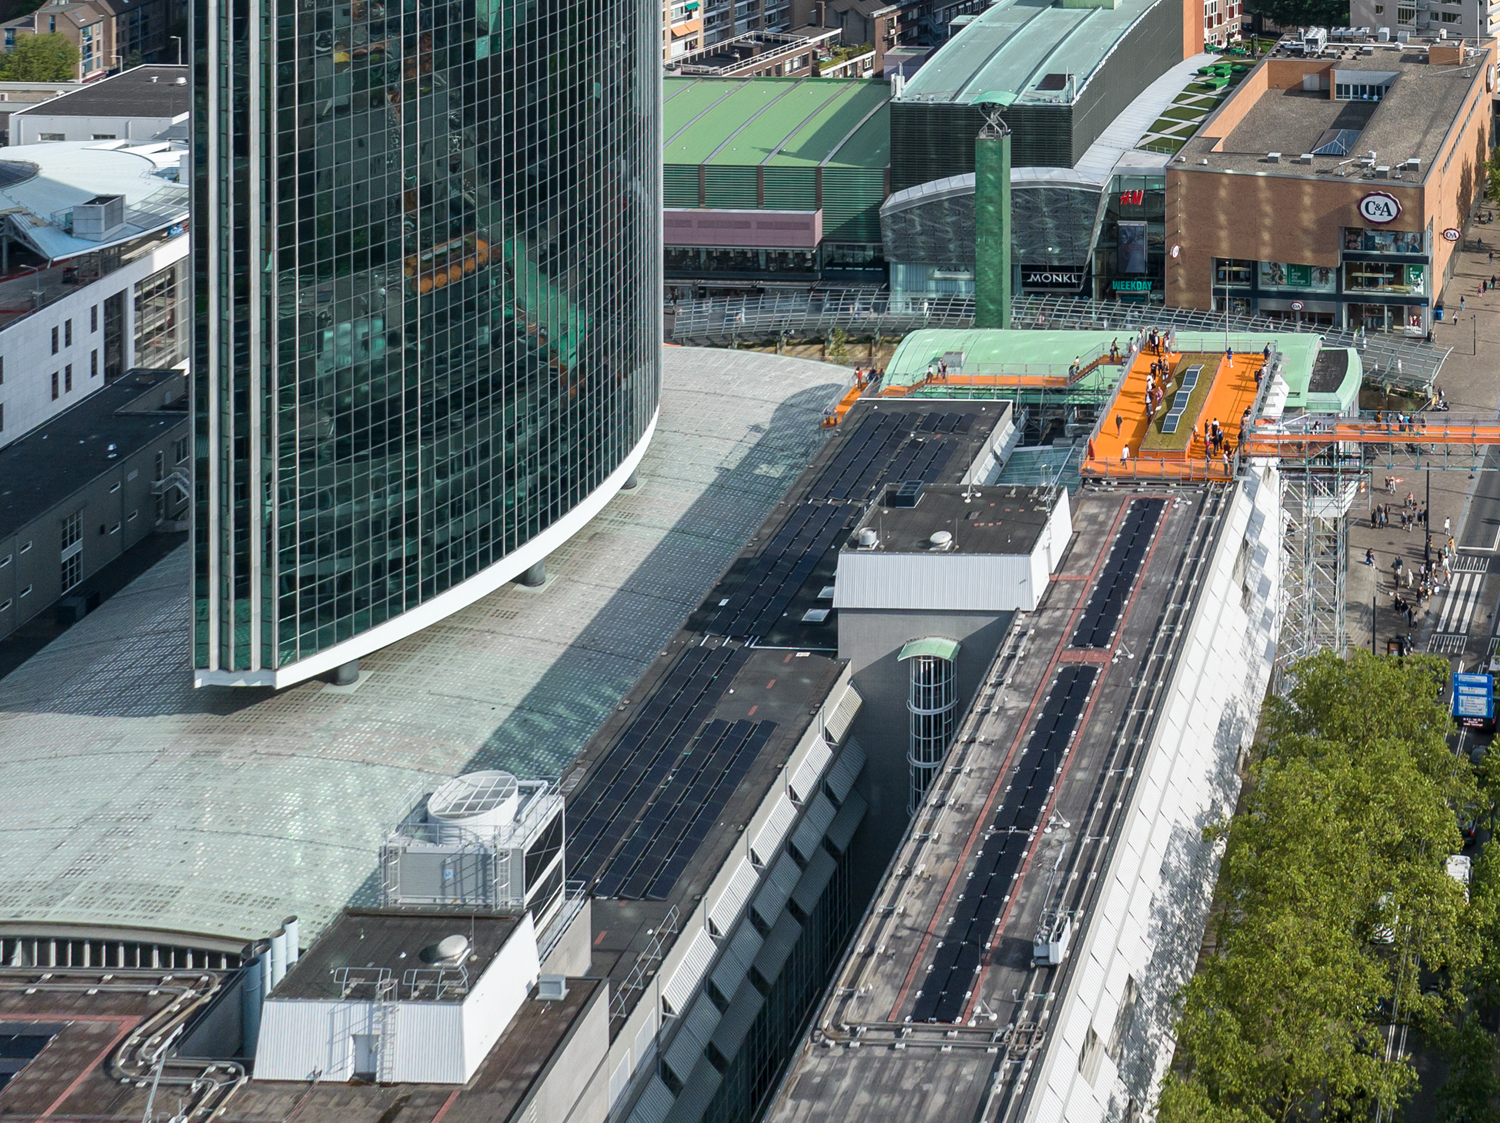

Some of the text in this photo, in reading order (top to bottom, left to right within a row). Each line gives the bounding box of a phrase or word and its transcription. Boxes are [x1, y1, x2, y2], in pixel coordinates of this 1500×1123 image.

[1120, 189, 1144, 206] H&M
[1364, 200, 1393, 217] C&A
[1445, 231, 1457, 239] C&A
[1112, 280, 1153, 291] WEEKDAY
